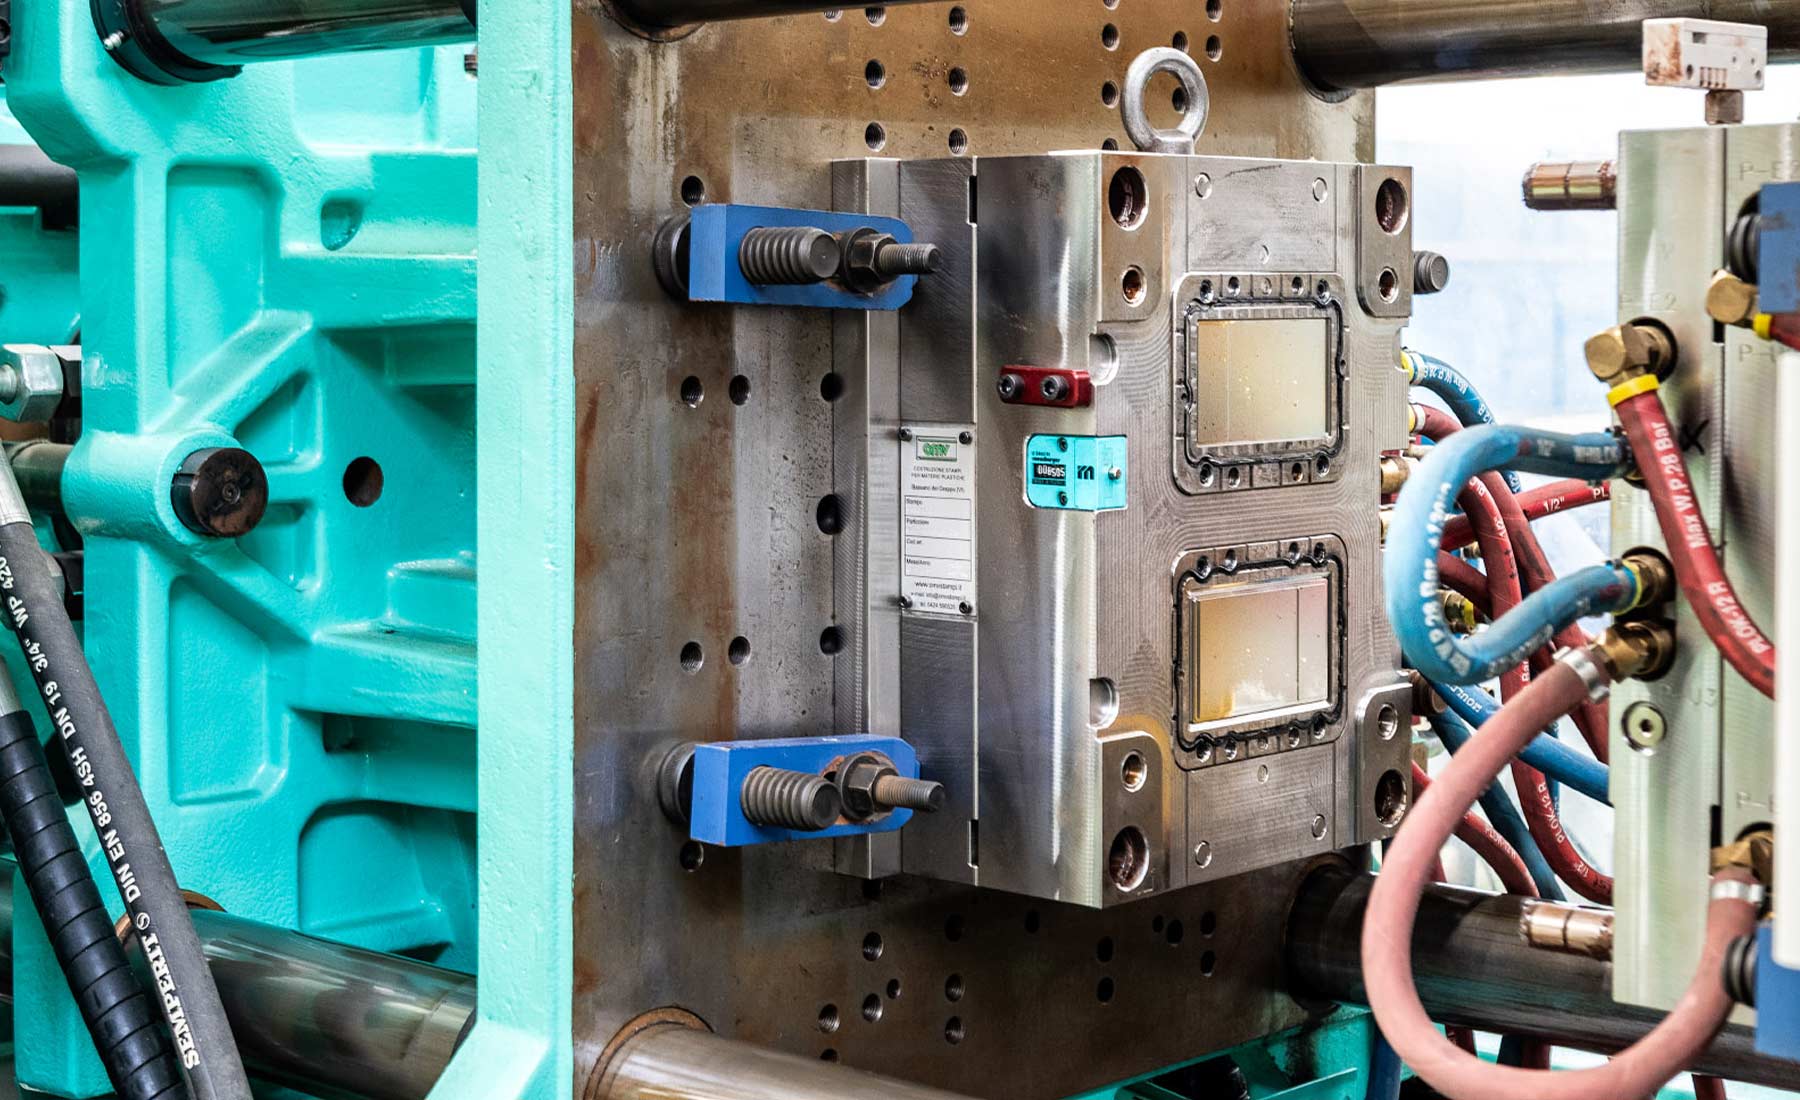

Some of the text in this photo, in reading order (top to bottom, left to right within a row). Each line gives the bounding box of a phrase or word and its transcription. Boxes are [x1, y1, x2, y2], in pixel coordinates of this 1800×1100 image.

[1650, 421, 1675, 452] Bar
[1681, 514, 1709, 550] Max
[8, 595, 30, 629] WP
[44, 680, 63, 706] 19
[55, 706, 78, 742] DN
[71, 745, 95, 787] 4SH
[89, 790, 113, 828] 856
[103, 828, 127, 862] EN
[116, 863, 142, 904] DIN
[142, 930, 201, 1071] SEMPERIT
